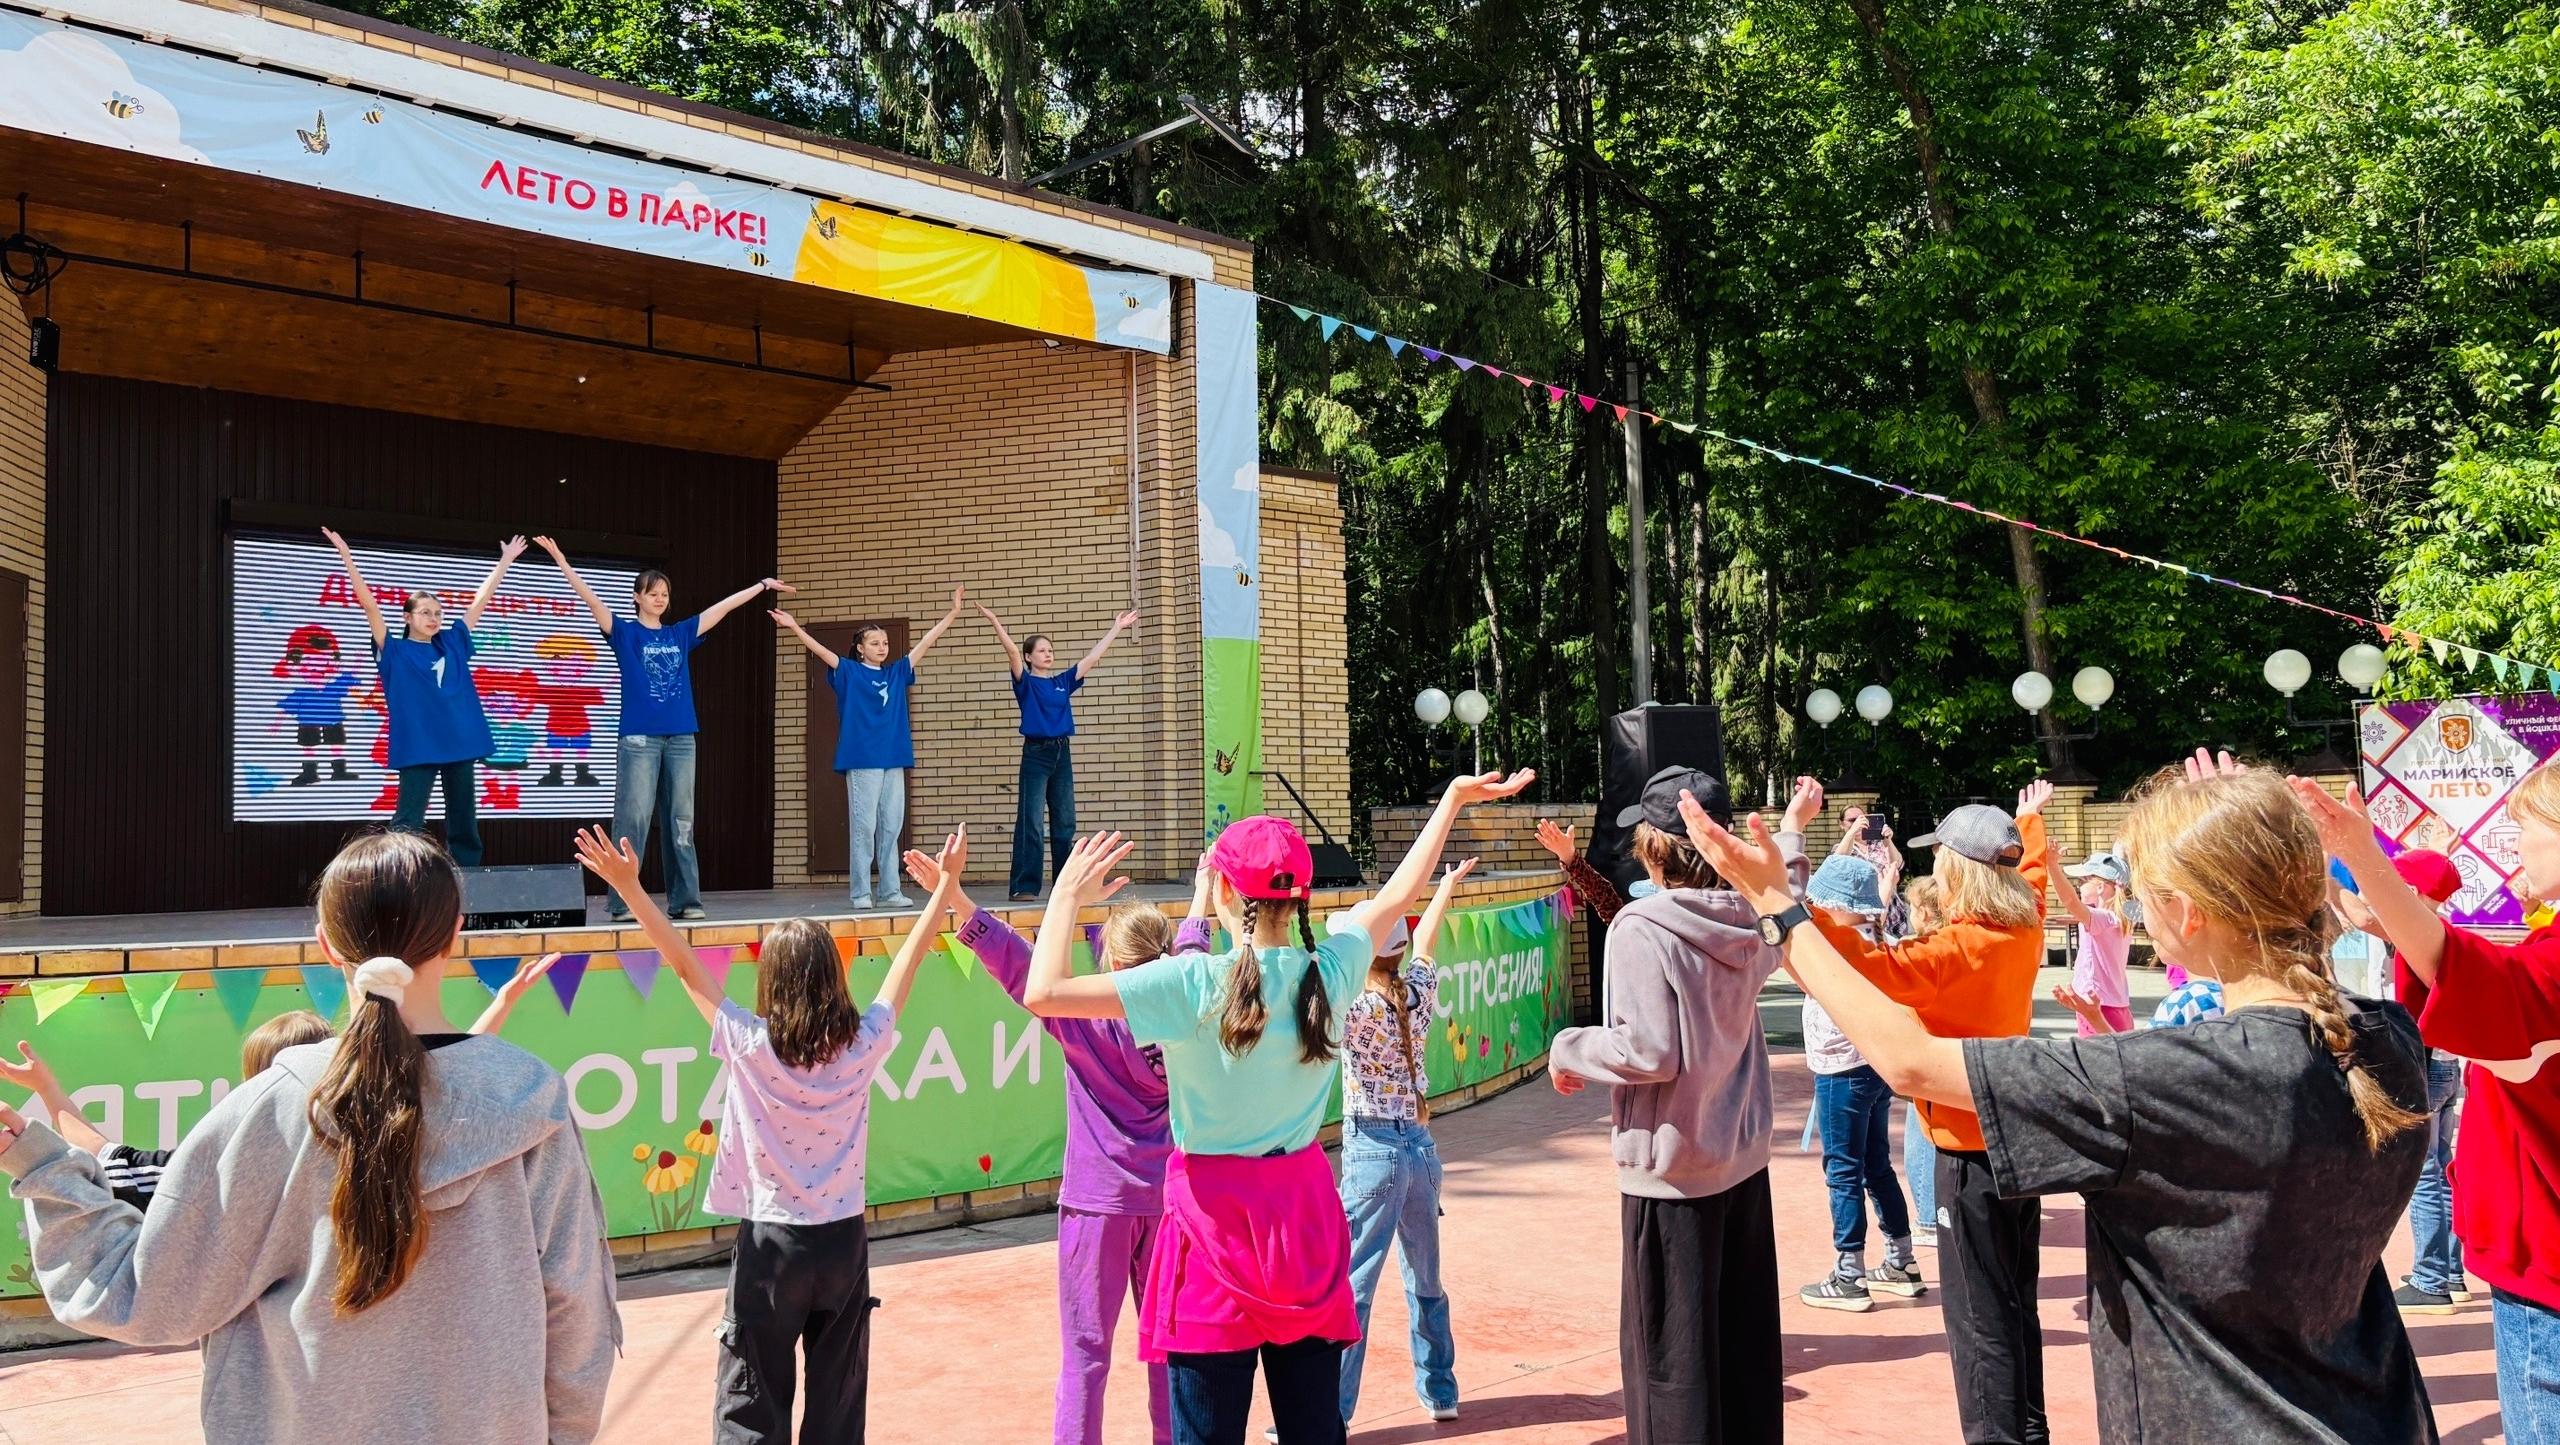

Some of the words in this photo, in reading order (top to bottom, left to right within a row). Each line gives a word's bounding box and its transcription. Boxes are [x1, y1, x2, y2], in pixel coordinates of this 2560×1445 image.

[480, 159, 596, 211] ЛЕТО
[608, 187, 629, 218] В
[639, 192, 768, 246] ПАРКЕ!
[2546, 715, 2560, 723] ФЕ
[2525, 724, 2560, 733] ЙОШКА
[2428, 781, 2493, 798] ЛЕТО
[992, 1017, 1042, 1090] И
[1433, 945, 1544, 1018] СТРОЕНИЯ!
